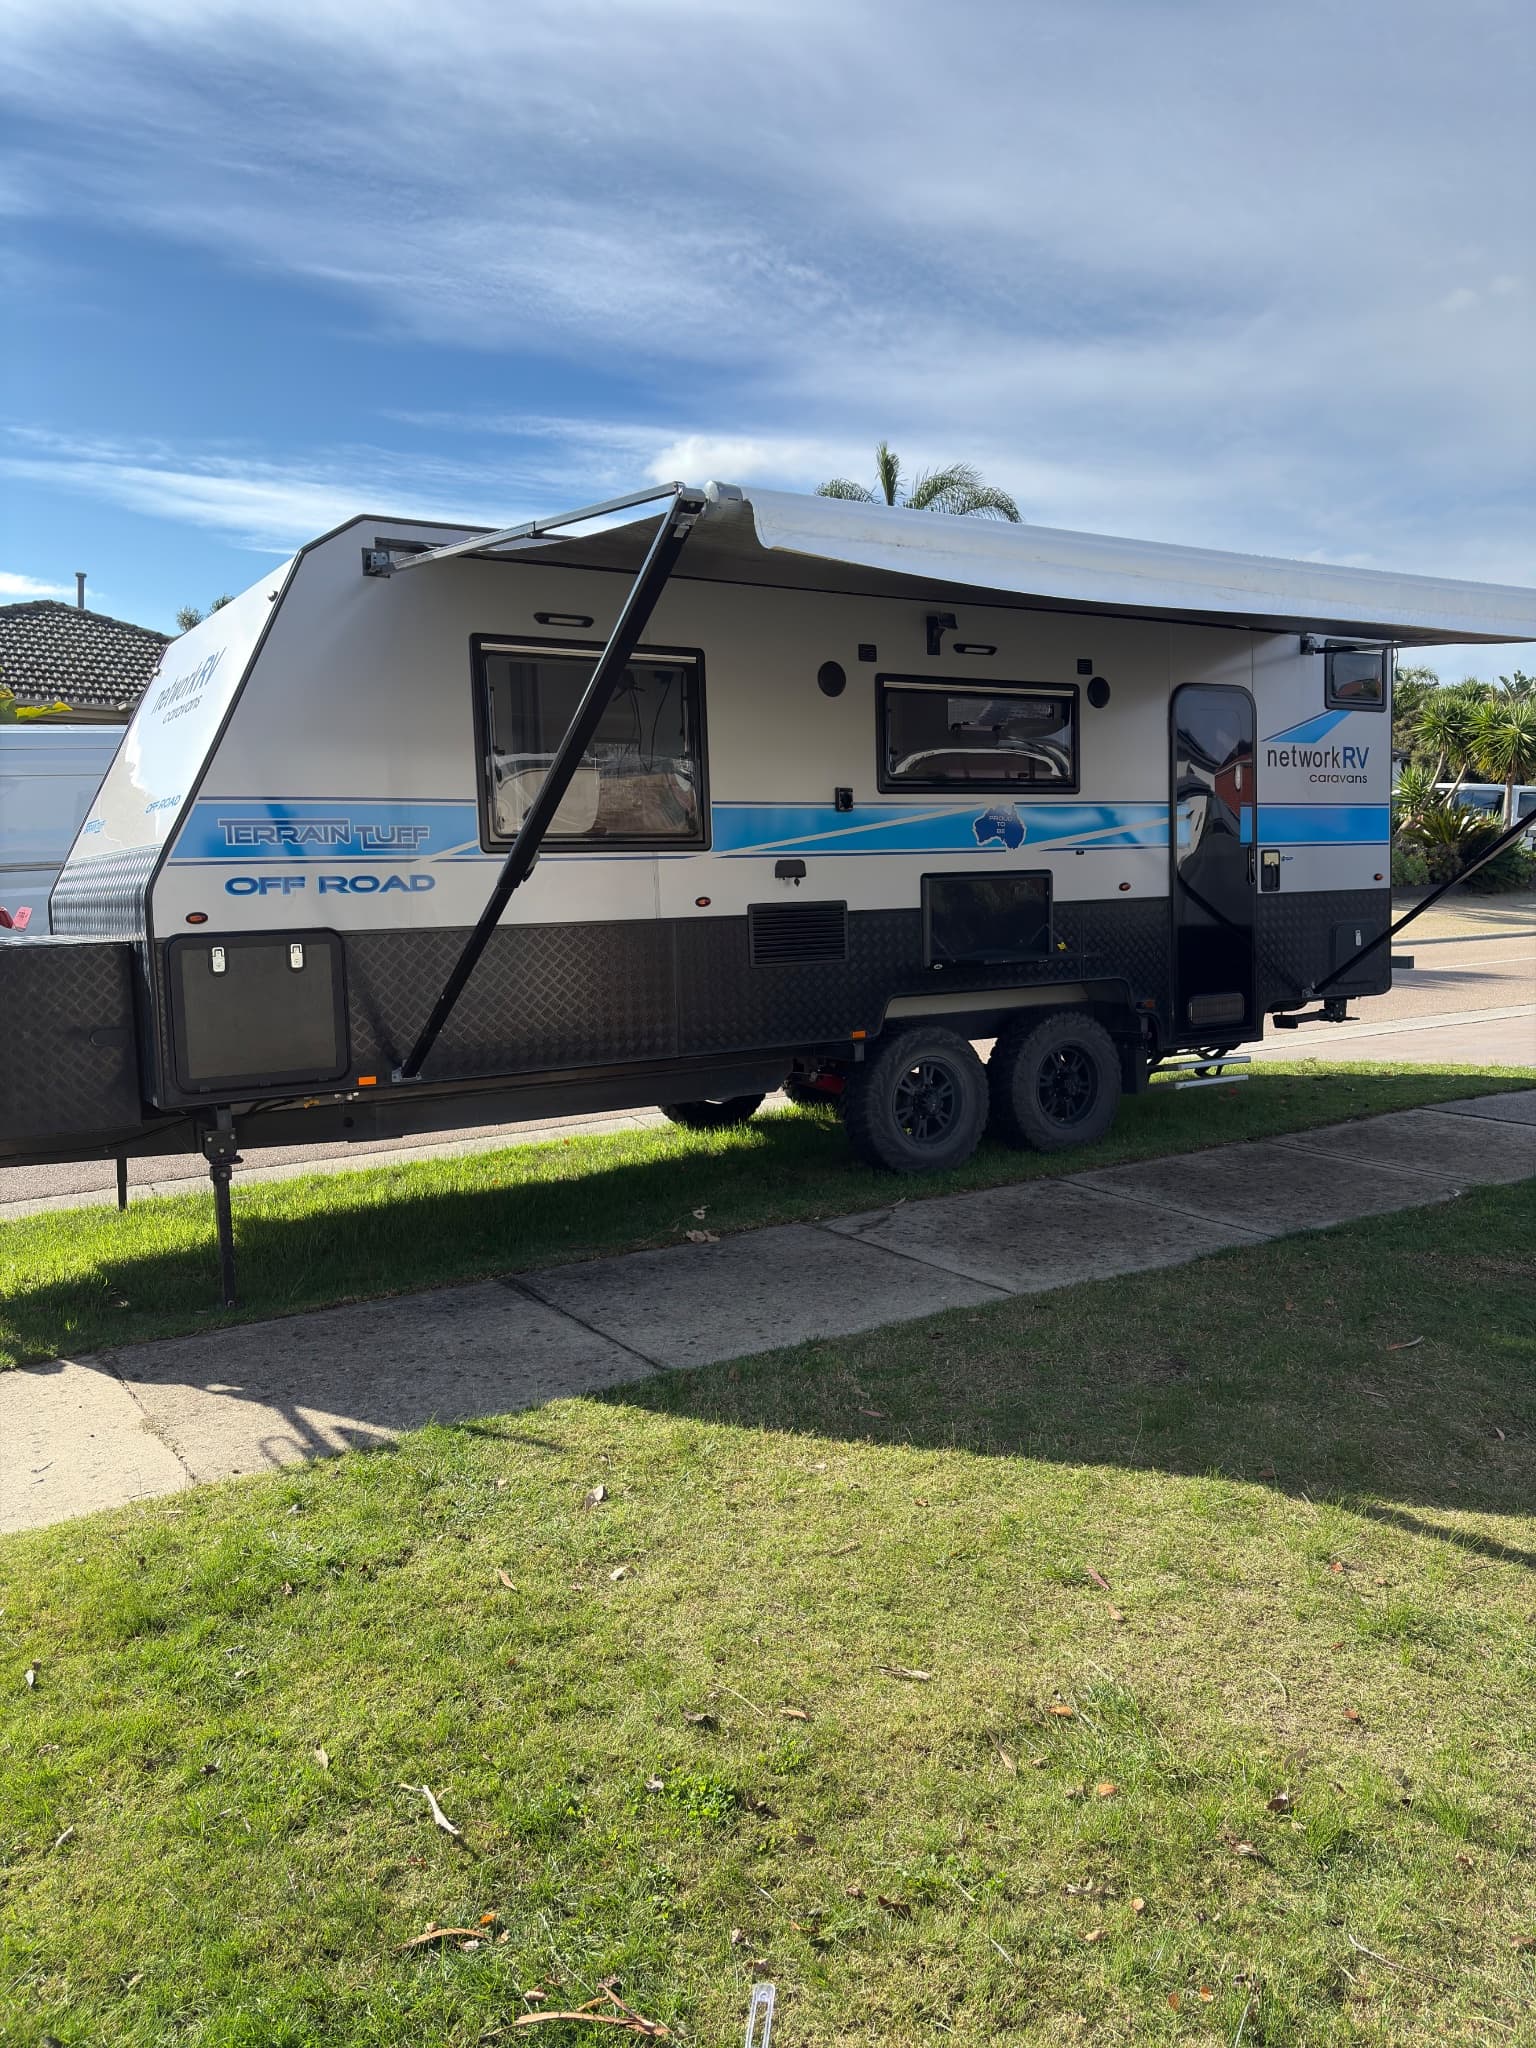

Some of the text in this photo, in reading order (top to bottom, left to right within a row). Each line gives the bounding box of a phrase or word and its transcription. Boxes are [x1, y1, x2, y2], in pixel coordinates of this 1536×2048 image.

[1267, 745, 1370, 769] networkRV
[1309, 774, 1368, 784] caravans
[218, 818, 430, 851] TERRAIN TUFF
[224, 874, 436, 896] OFF ROAD
